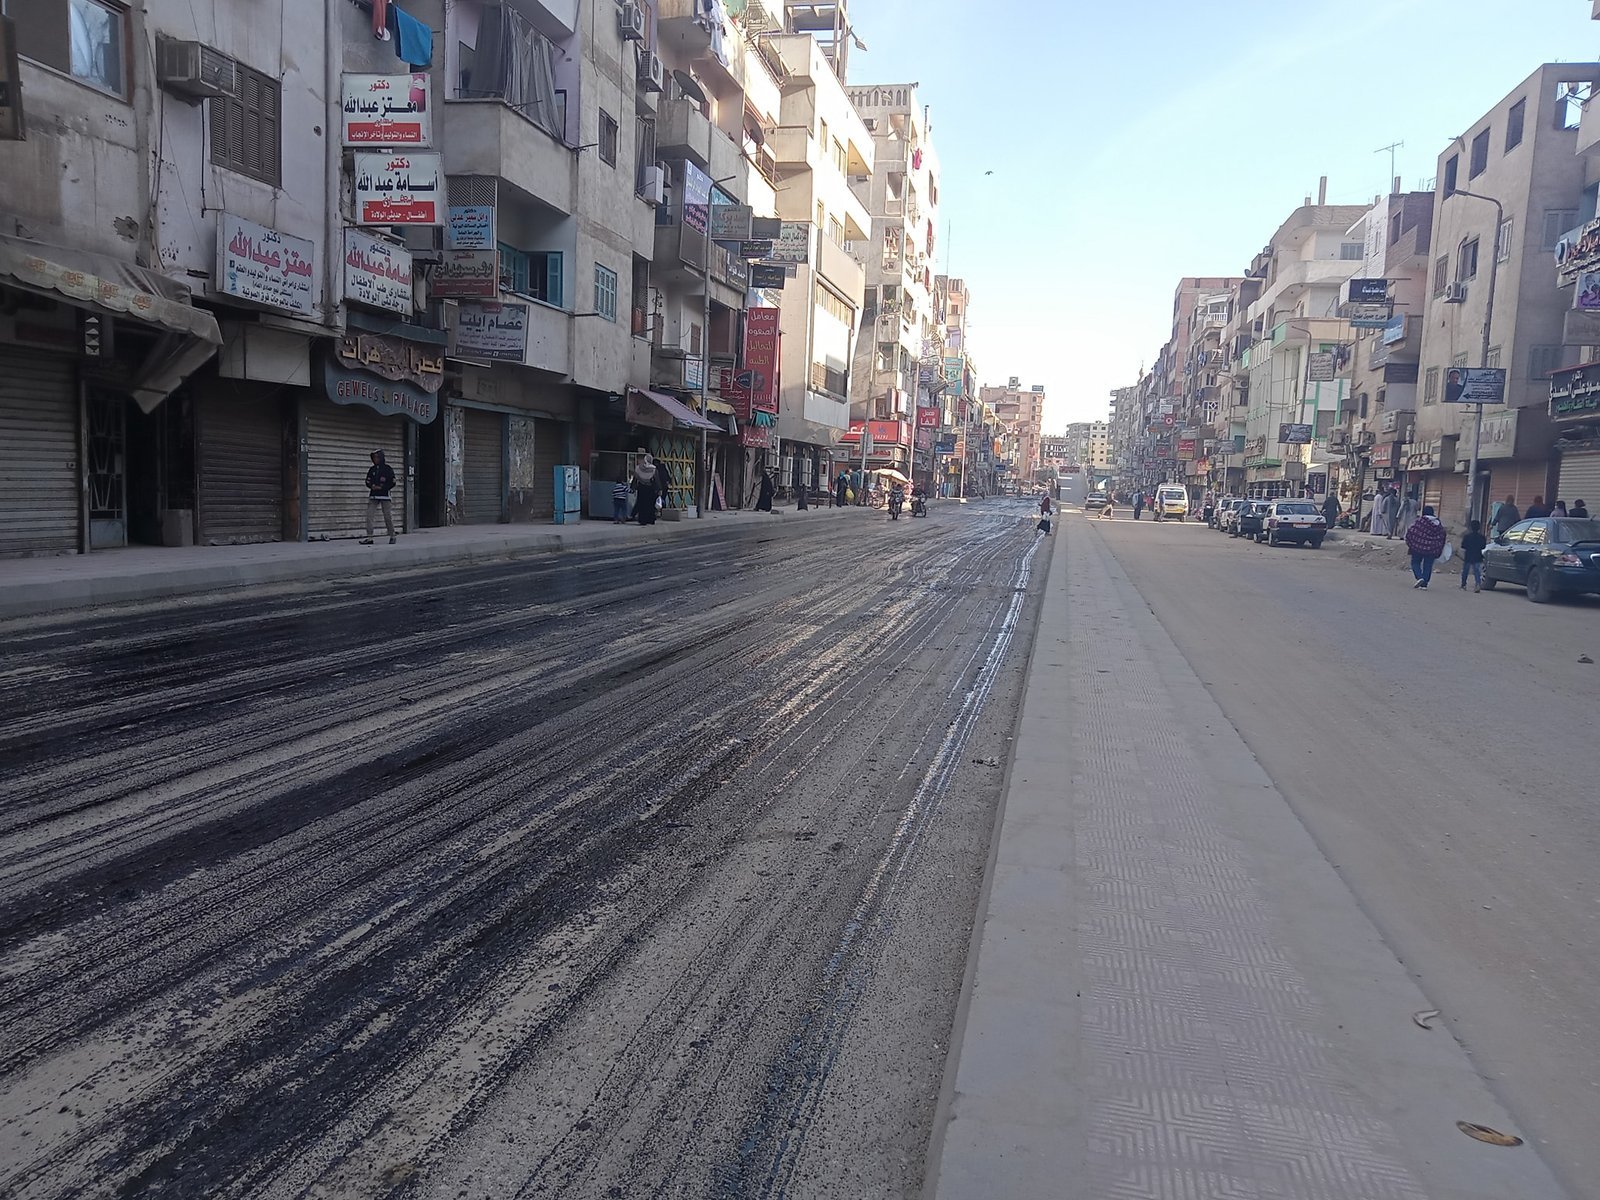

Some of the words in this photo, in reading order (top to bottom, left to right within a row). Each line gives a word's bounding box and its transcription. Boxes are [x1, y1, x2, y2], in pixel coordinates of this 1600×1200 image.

[368, 80, 390, 92] دكتور
[381, 96, 416, 118] معتز
[384, 158, 410, 172] دكتور
[358, 168, 372, 192] الله
[374, 176, 394, 197] عبد
[396, 170, 438, 192] أسامة
[262, 230, 280, 244] دكتور
[370, 242, 391, 256] دكتور
[281, 248, 312, 278] معتز
[488, 314, 523, 332] عصام
[750, 310, 775, 321] معامل
[747, 340, 774, 352] للتحاليل
[336, 379, 378, 402] GEWELS
[392, 391, 430, 419] PALACE
